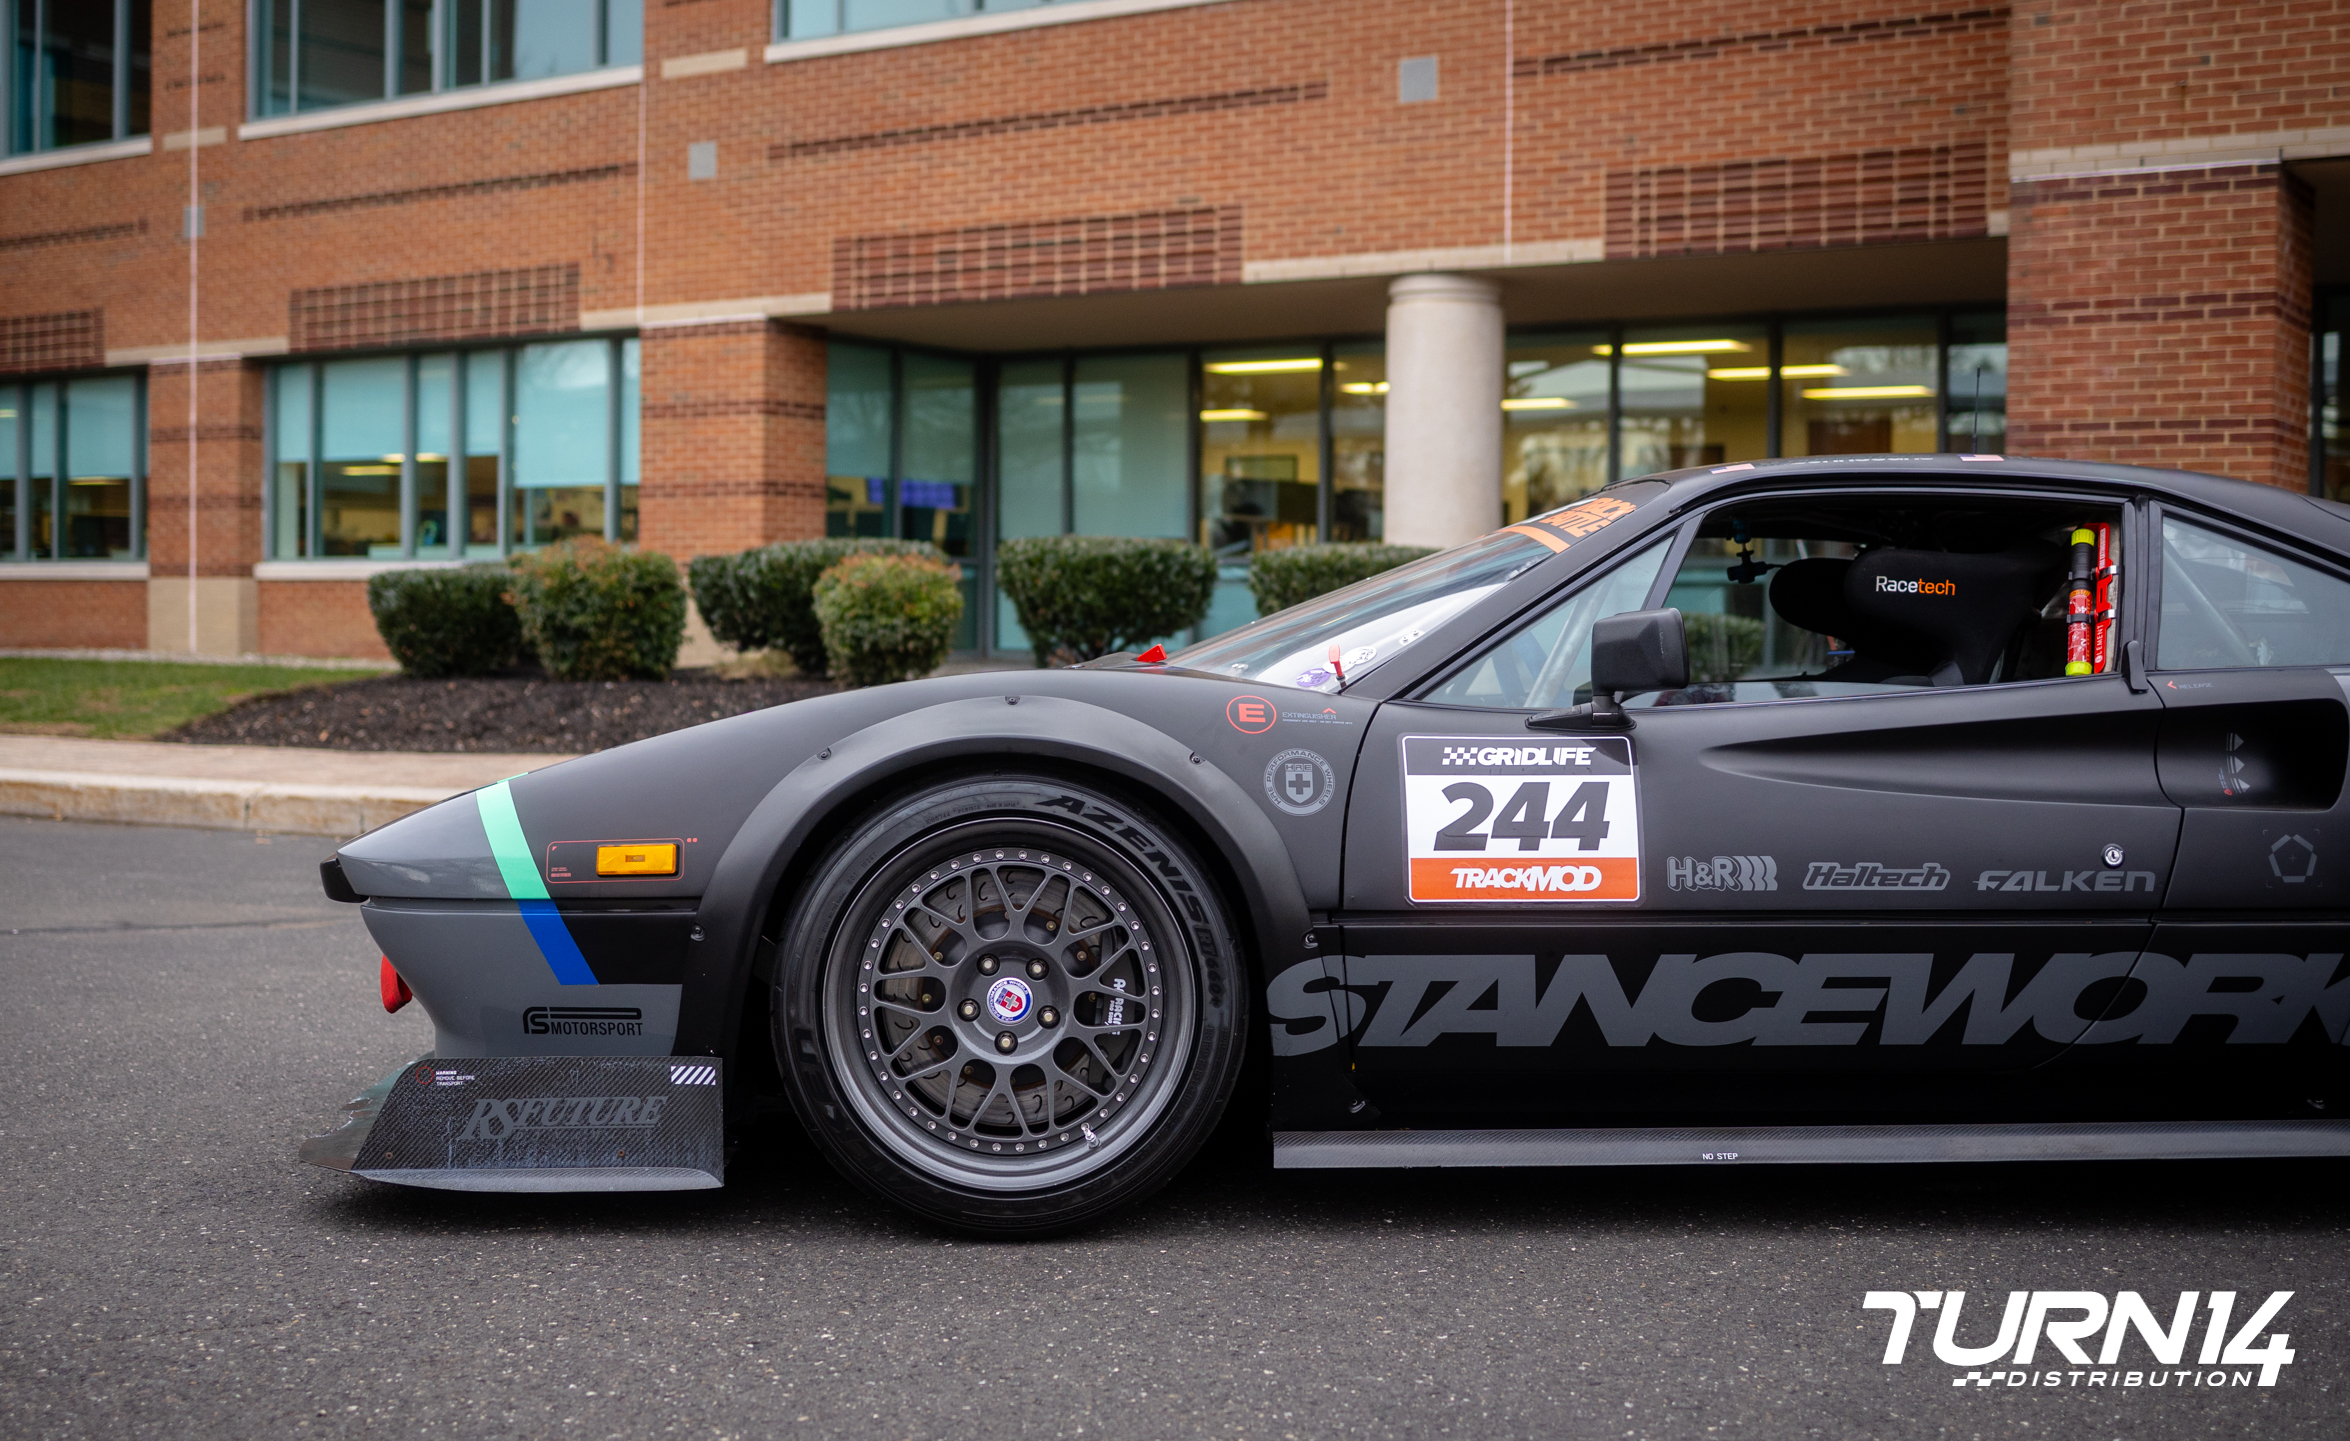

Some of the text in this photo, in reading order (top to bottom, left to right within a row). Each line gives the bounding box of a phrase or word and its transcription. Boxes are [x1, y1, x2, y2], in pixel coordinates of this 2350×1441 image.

[1875, 575, 1956, 596] Racetech
[1282, 711, 1337, 720] EXTINGUISHER
[1285, 763, 1312, 772] HRE
[1477, 747, 1597, 766] GRIDLIFE
[1266, 750, 1326, 782] PERFORMANCE
[1318, 768, 1333, 806] WHEELS
[1433, 781, 1610, 851] 244
[1034, 795, 1209, 926] AZENIS
[1450, 865, 1602, 892] TRACKMOD
[1667, 856, 1740, 891] H&R
[1803, 862, 1950, 890] Haltech
[1973, 870, 2156, 892] FALKEN
[551, 1021, 643, 1035] MOTORSPORT
[1717, 1152, 1738, 1160] STEP
